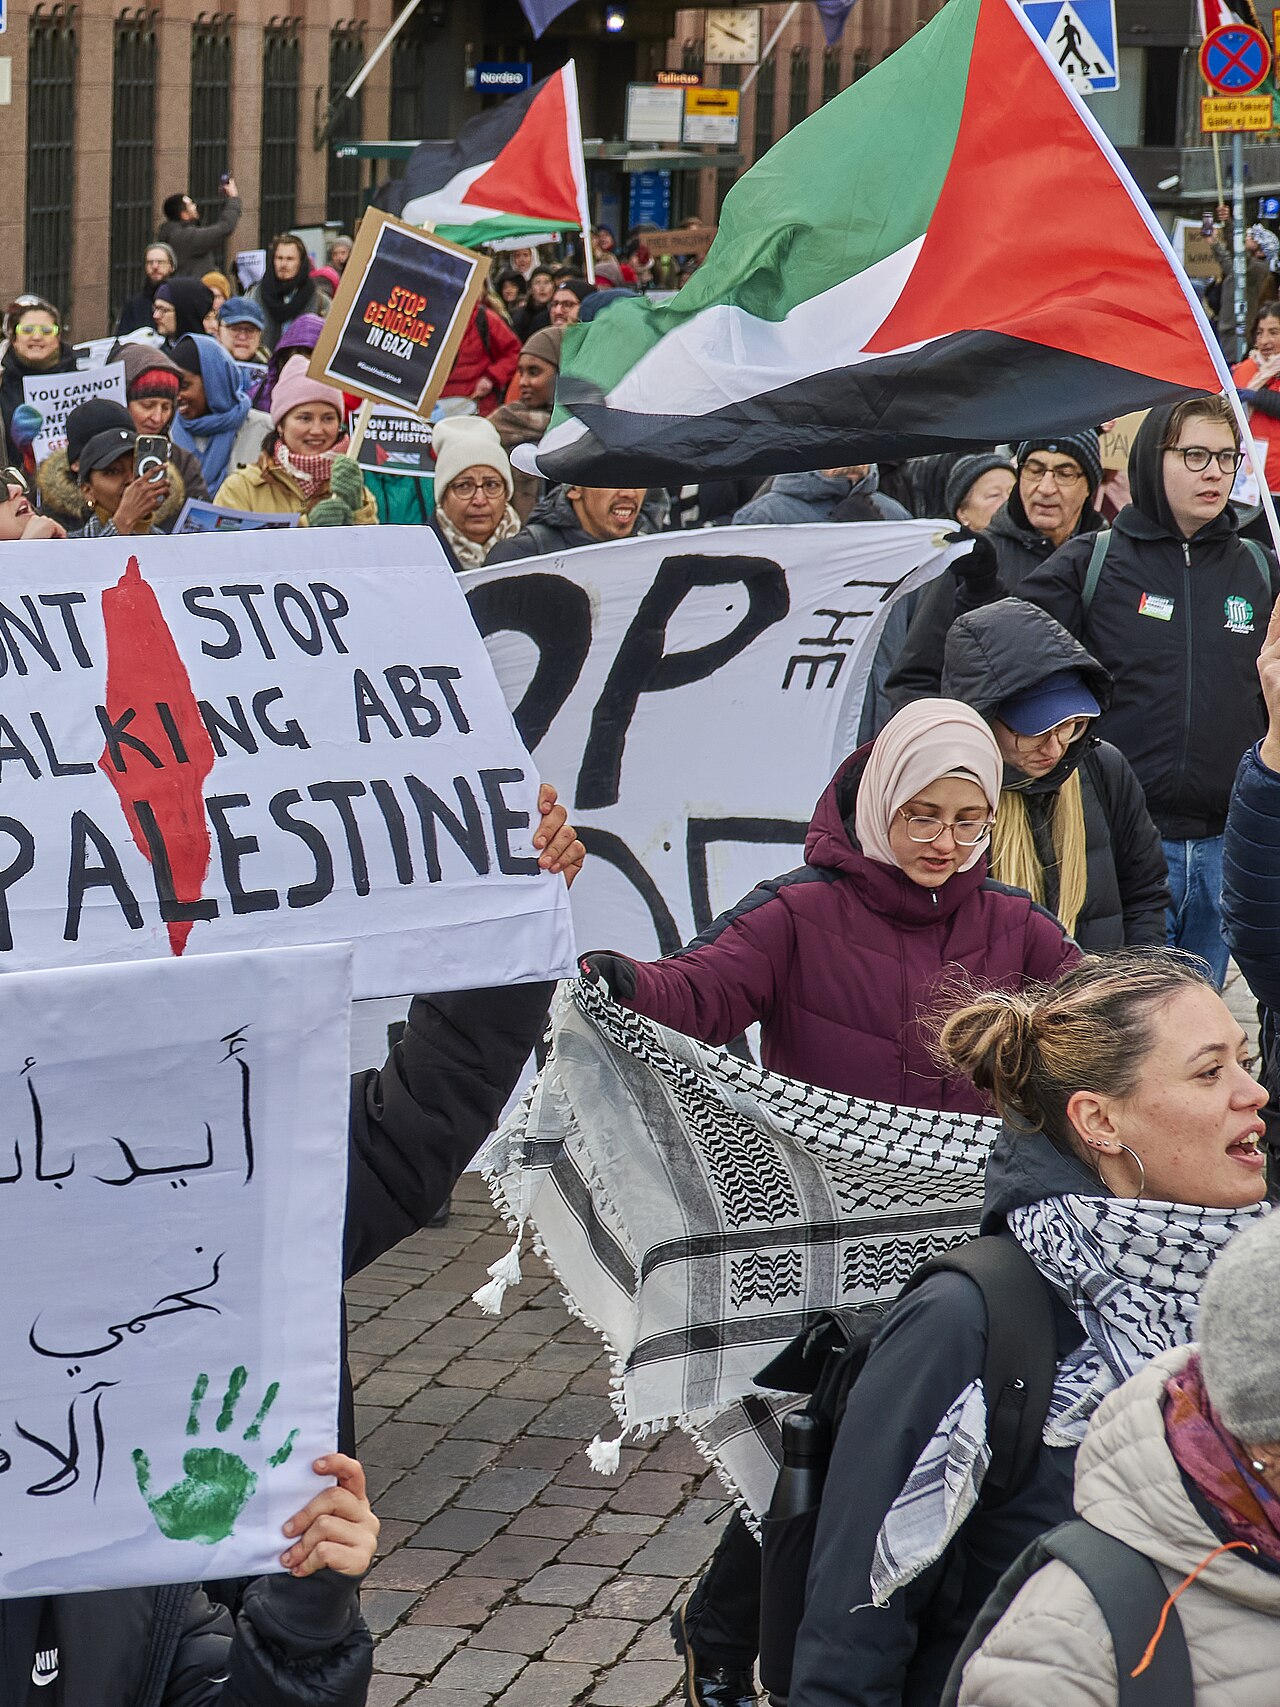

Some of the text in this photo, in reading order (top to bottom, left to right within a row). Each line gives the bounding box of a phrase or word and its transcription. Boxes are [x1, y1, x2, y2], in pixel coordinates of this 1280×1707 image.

[387, 285, 428, 318] STOP
[363, 300, 436, 348] GENOCIDE
[365, 326, 415, 361] IN GAZA
[29, 376, 120, 401] YOU CANNOT
[368, 419, 387, 430] ON
[388, 420, 409, 431] THE
[379, 430, 395, 442] OF
[182, 582, 350, 660] STOP
[353, 664, 474, 744] ABT
[35, 1647, 59, 1672] NIK
